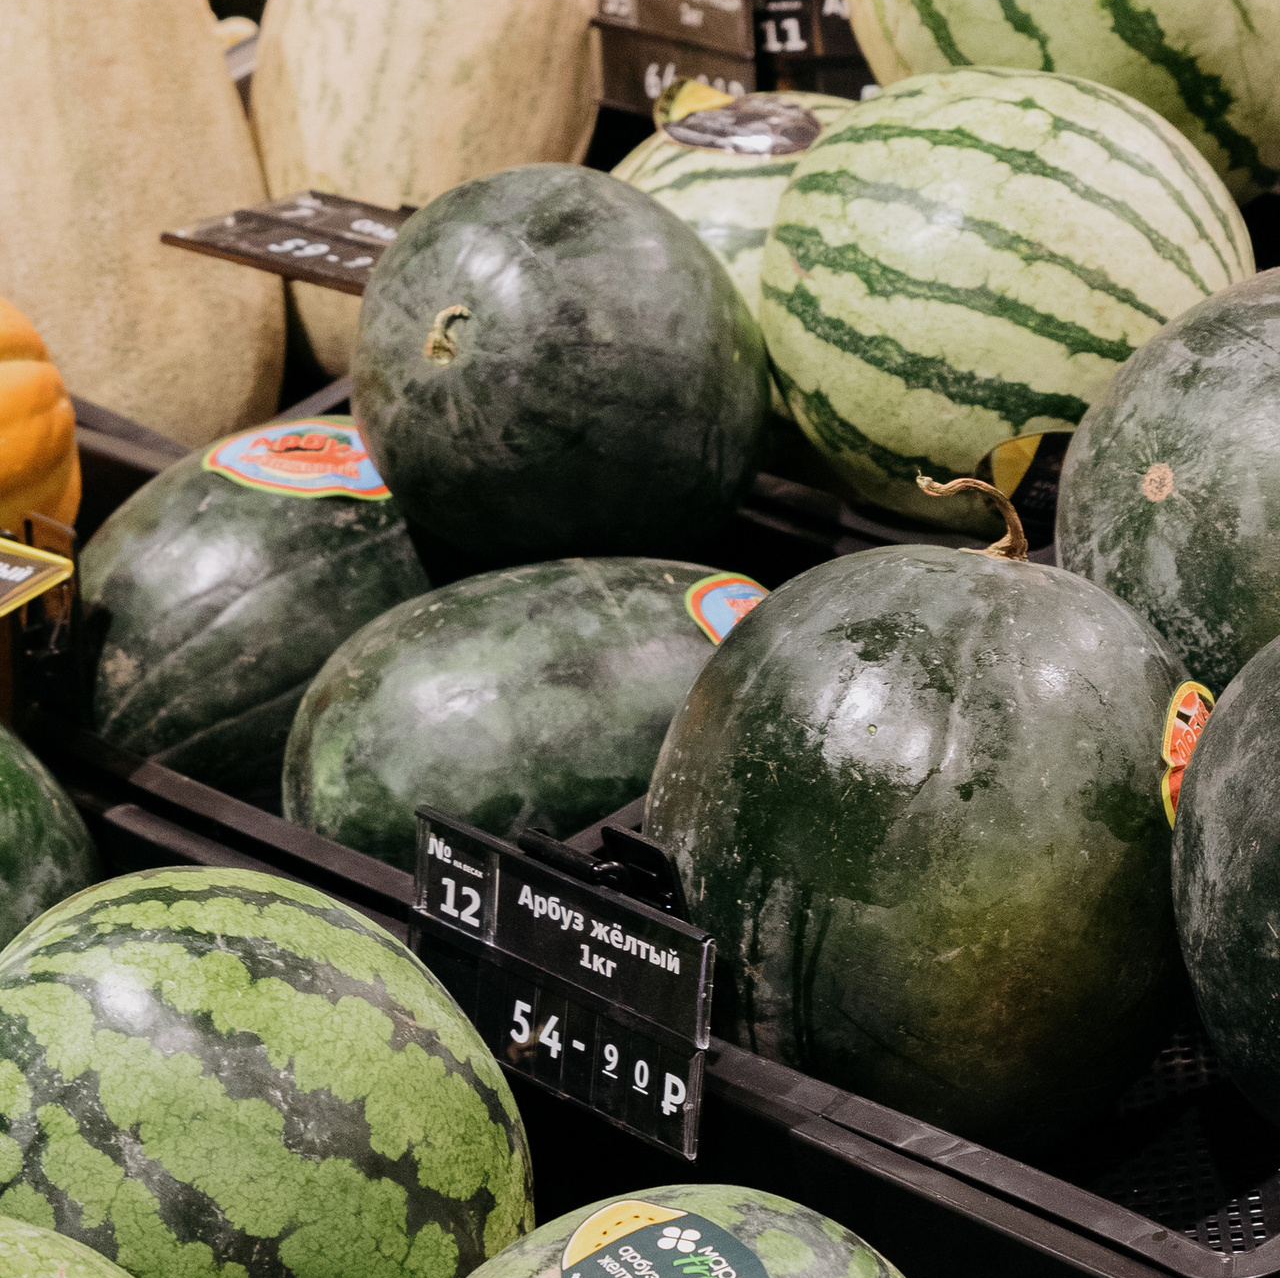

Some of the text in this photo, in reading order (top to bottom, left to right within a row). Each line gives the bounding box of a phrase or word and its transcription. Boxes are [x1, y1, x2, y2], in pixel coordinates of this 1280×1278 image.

[761, 17, 808, 53] 11
[428, 832, 452, 864] №
[439, 876, 482, 928] 12
[517, 884, 681, 975] Арбуз жёлтый
[578, 943, 618, 980] 1кг
